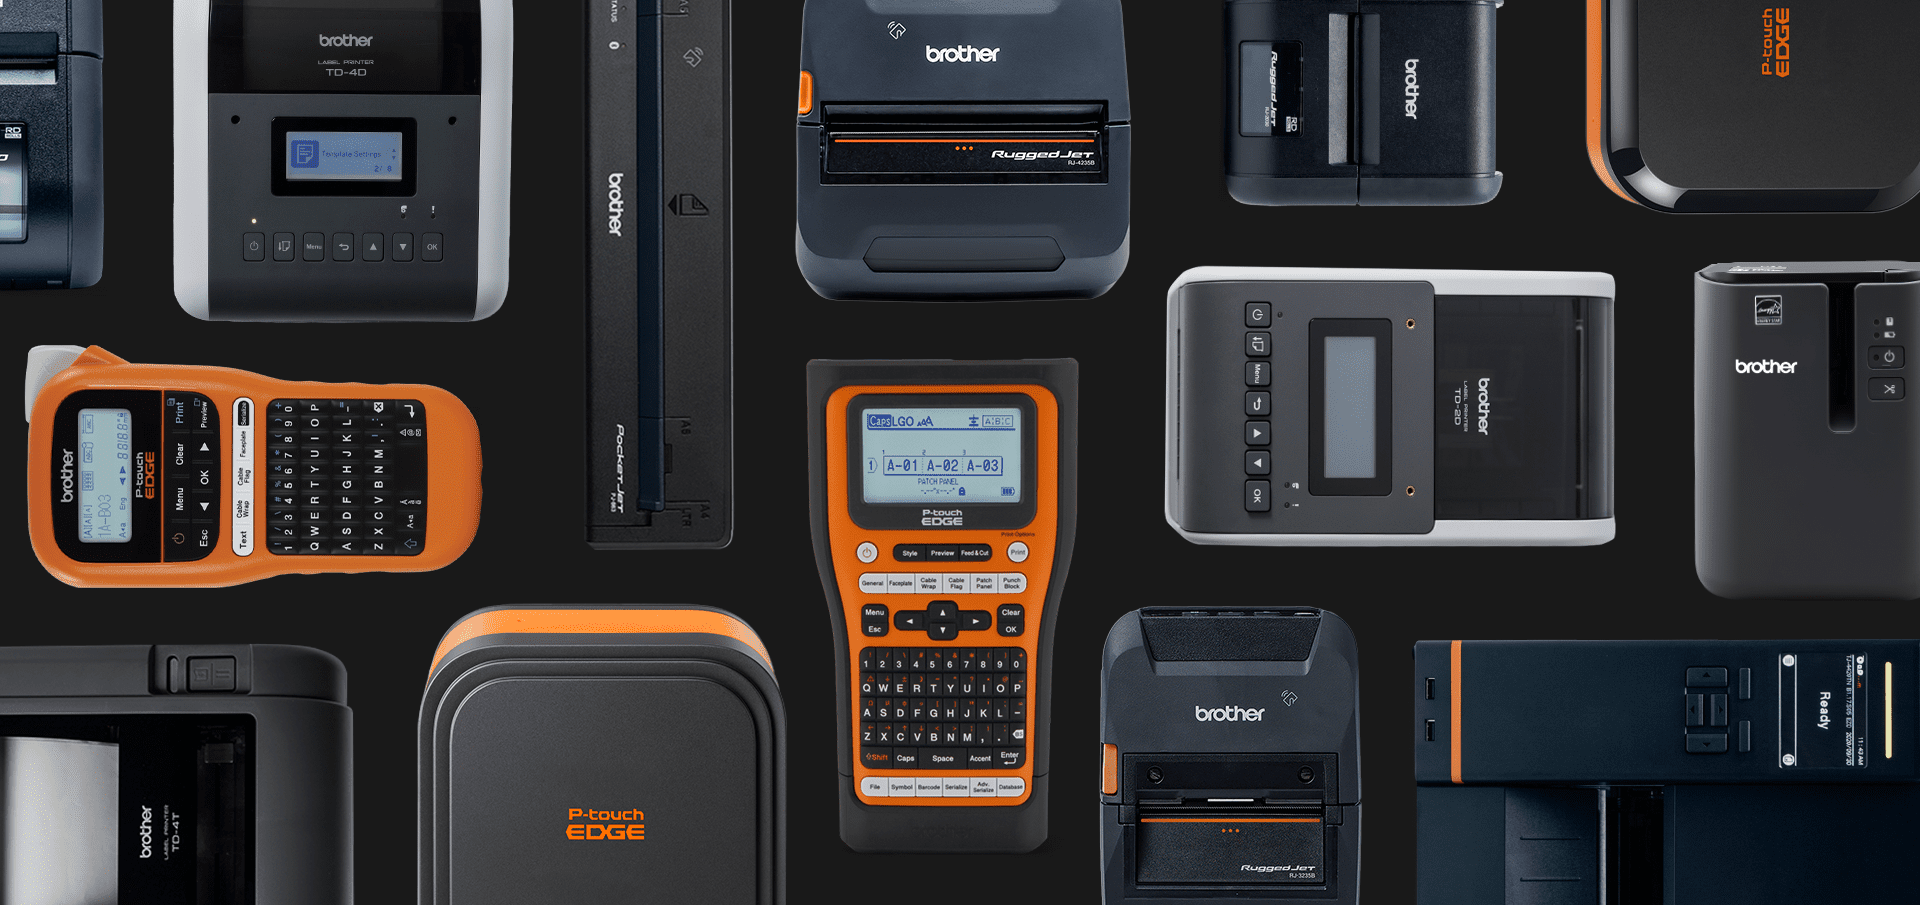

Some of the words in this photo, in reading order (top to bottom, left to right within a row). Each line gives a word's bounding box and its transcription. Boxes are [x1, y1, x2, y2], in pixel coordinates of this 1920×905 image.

[319, 33, 374, 47] brother
[1761, 8, 1773, 76] P-touch
[1775, 7, 1790, 78] EDGE
[925, 44, 1000, 63] brother
[325, 68, 367, 77] TD-4D
[1404, 58, 1420, 120] brother
[608, 172, 624, 237] brother
[426, 243, 438, 251] OK
[1735, 358, 1798, 374] brother
[175, 401, 184, 424] Print
[1454, 387, 1462, 426] TD-2D
[1478, 377, 1491, 436] brother
[200, 401, 208, 429] Preview
[869, 415, 891, 428] Caps
[680, 419, 691, 435] A6
[239, 430, 247, 458] Faceplate
[175, 442, 184, 466] Clear
[886, 458, 918, 472] A-01
[926, 458, 959, 472] A-02
[966, 458, 999, 472] A-03
[60, 448, 74, 503] brother
[135, 451, 144, 499] P-touch
[144, 451, 155, 500] EDGE
[199, 469, 209, 485] OK
[243, 469, 251, 484] Flag
[917, 478, 938, 486] PATCH
[939, 478, 959, 486] PANEL
[119, 496, 128, 511] Eng
[175, 487, 184, 511] Menu
[1253, 488, 1262, 504] OK
[242, 500, 250, 518] Wrap
[699, 504, 710, 520] A4
[921, 517, 963, 526] EDGE
[199, 528, 209, 547] Esc
[239, 530, 247, 550] Text
[889, 580, 913, 588] Faceplate
[865, 608, 885, 616] Menu
[1001, 608, 1021, 616] Clear
[868, 625, 882, 633] Esc
[1005, 625, 1017, 633] OK
[896, 660, 902, 668] 3
[930, 660, 936, 668] 5
[946, 660, 952, 668] 6
[980, 660, 986, 668] 8
[996, 660, 1002, 668] 9
[1014, 660, 1020, 668] 0
[862, 684, 870, 692] Q
[878, 684, 888, 692] W
[896, 684, 904, 692] E
[914, 684, 920, 692] R
[930, 684, 938, 692] T
[946, 684, 954, 692] Y
[964, 684, 970, 692] U
[996, 684, 1004, 692] O
[1014, 684, 1022, 692] P
[864, 708, 872, 716] A
[880, 708, 888, 718] S
[896, 708, 904, 718] D
[914, 708, 920, 718] F
[930, 708, 938, 718] G
[946, 708, 954, 718] H
[964, 708, 970, 718] J
[980, 708, 988, 718] K
[997, 708, 1003, 718] L
[1195, 705, 1266, 722] brother
[1817, 691, 1831, 730] Ready
[864, 732, 870, 740] Z
[880, 732, 888, 740] X
[896, 732, 904, 742] C
[914, 732, 922, 742] V
[930, 732, 938, 742] B
[948, 732, 954, 742] N
[964, 732, 972, 742] M
[872, 753, 888, 761] Shift
[896, 755, 915, 763] Caps
[932, 755, 954, 763] Space
[1000, 751, 1020, 759] Enter
[568, 807, 645, 821] P-touch
[139, 805, 153, 859] brother
[171, 811, 180, 853] TD-4T
[565, 823, 645, 841] EDGE
